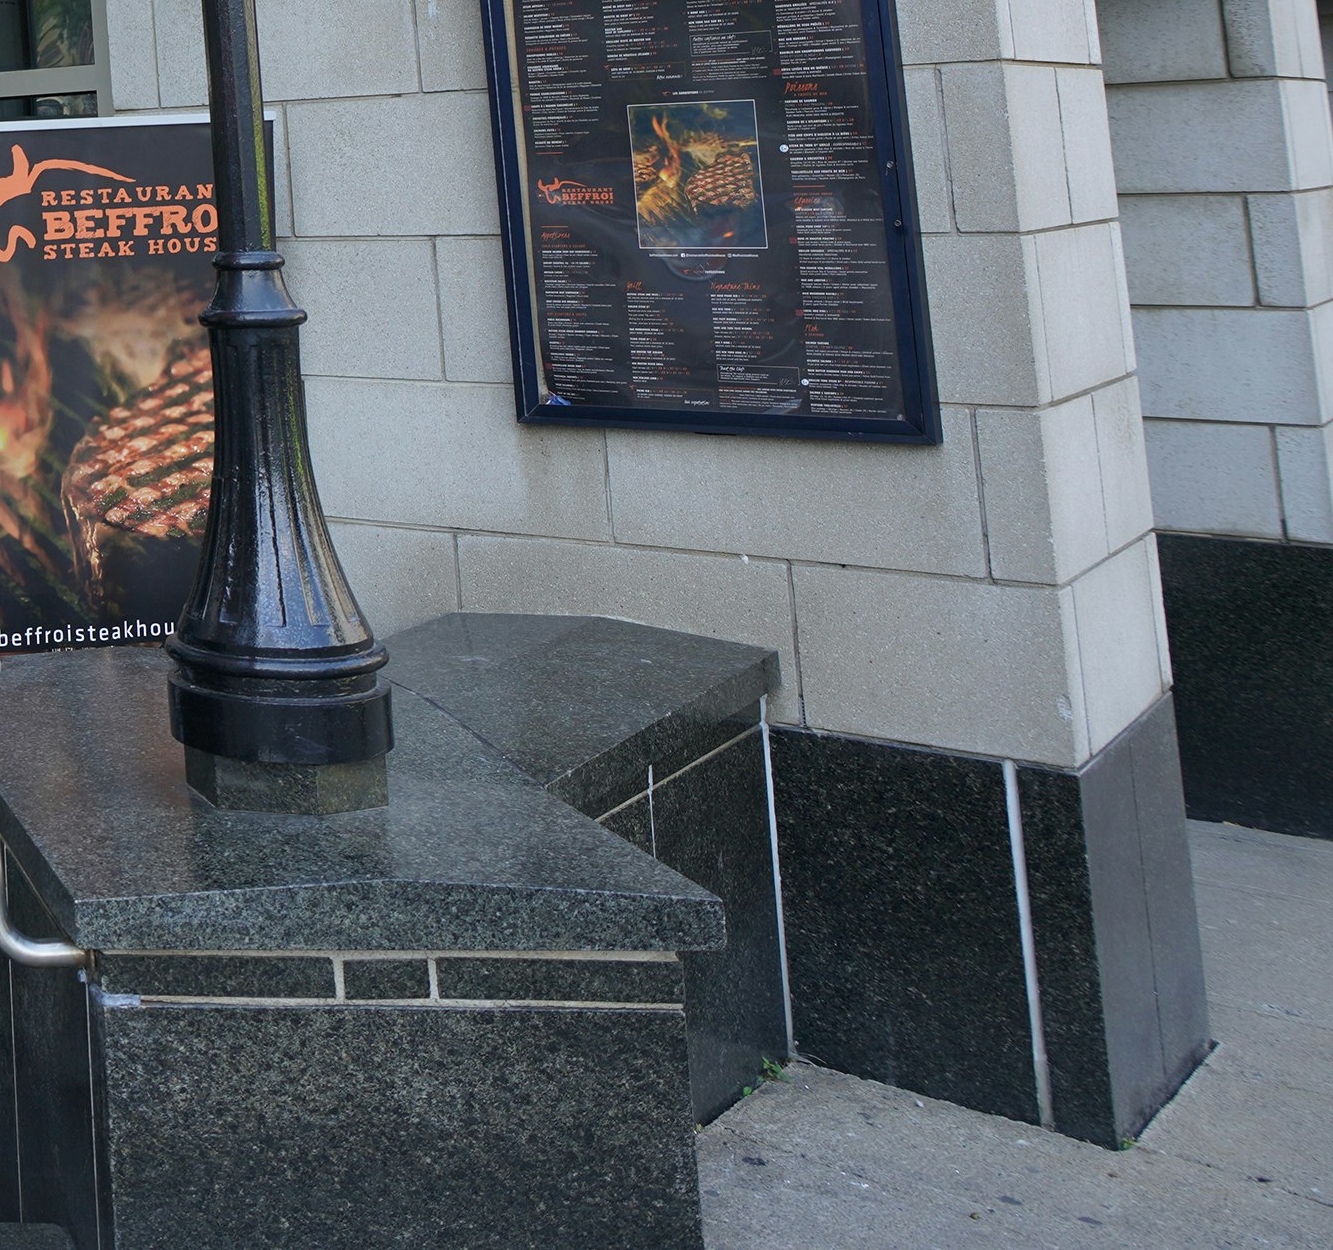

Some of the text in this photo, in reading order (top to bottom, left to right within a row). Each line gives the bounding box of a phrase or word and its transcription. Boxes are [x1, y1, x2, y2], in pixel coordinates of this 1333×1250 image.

[41, 183, 214, 207] RESTAURAN
[562, 192, 614, 201] BEFFROI
[42, 203, 219, 241] BEFFRO
[44, 236, 218, 260] STEAK HOUS
